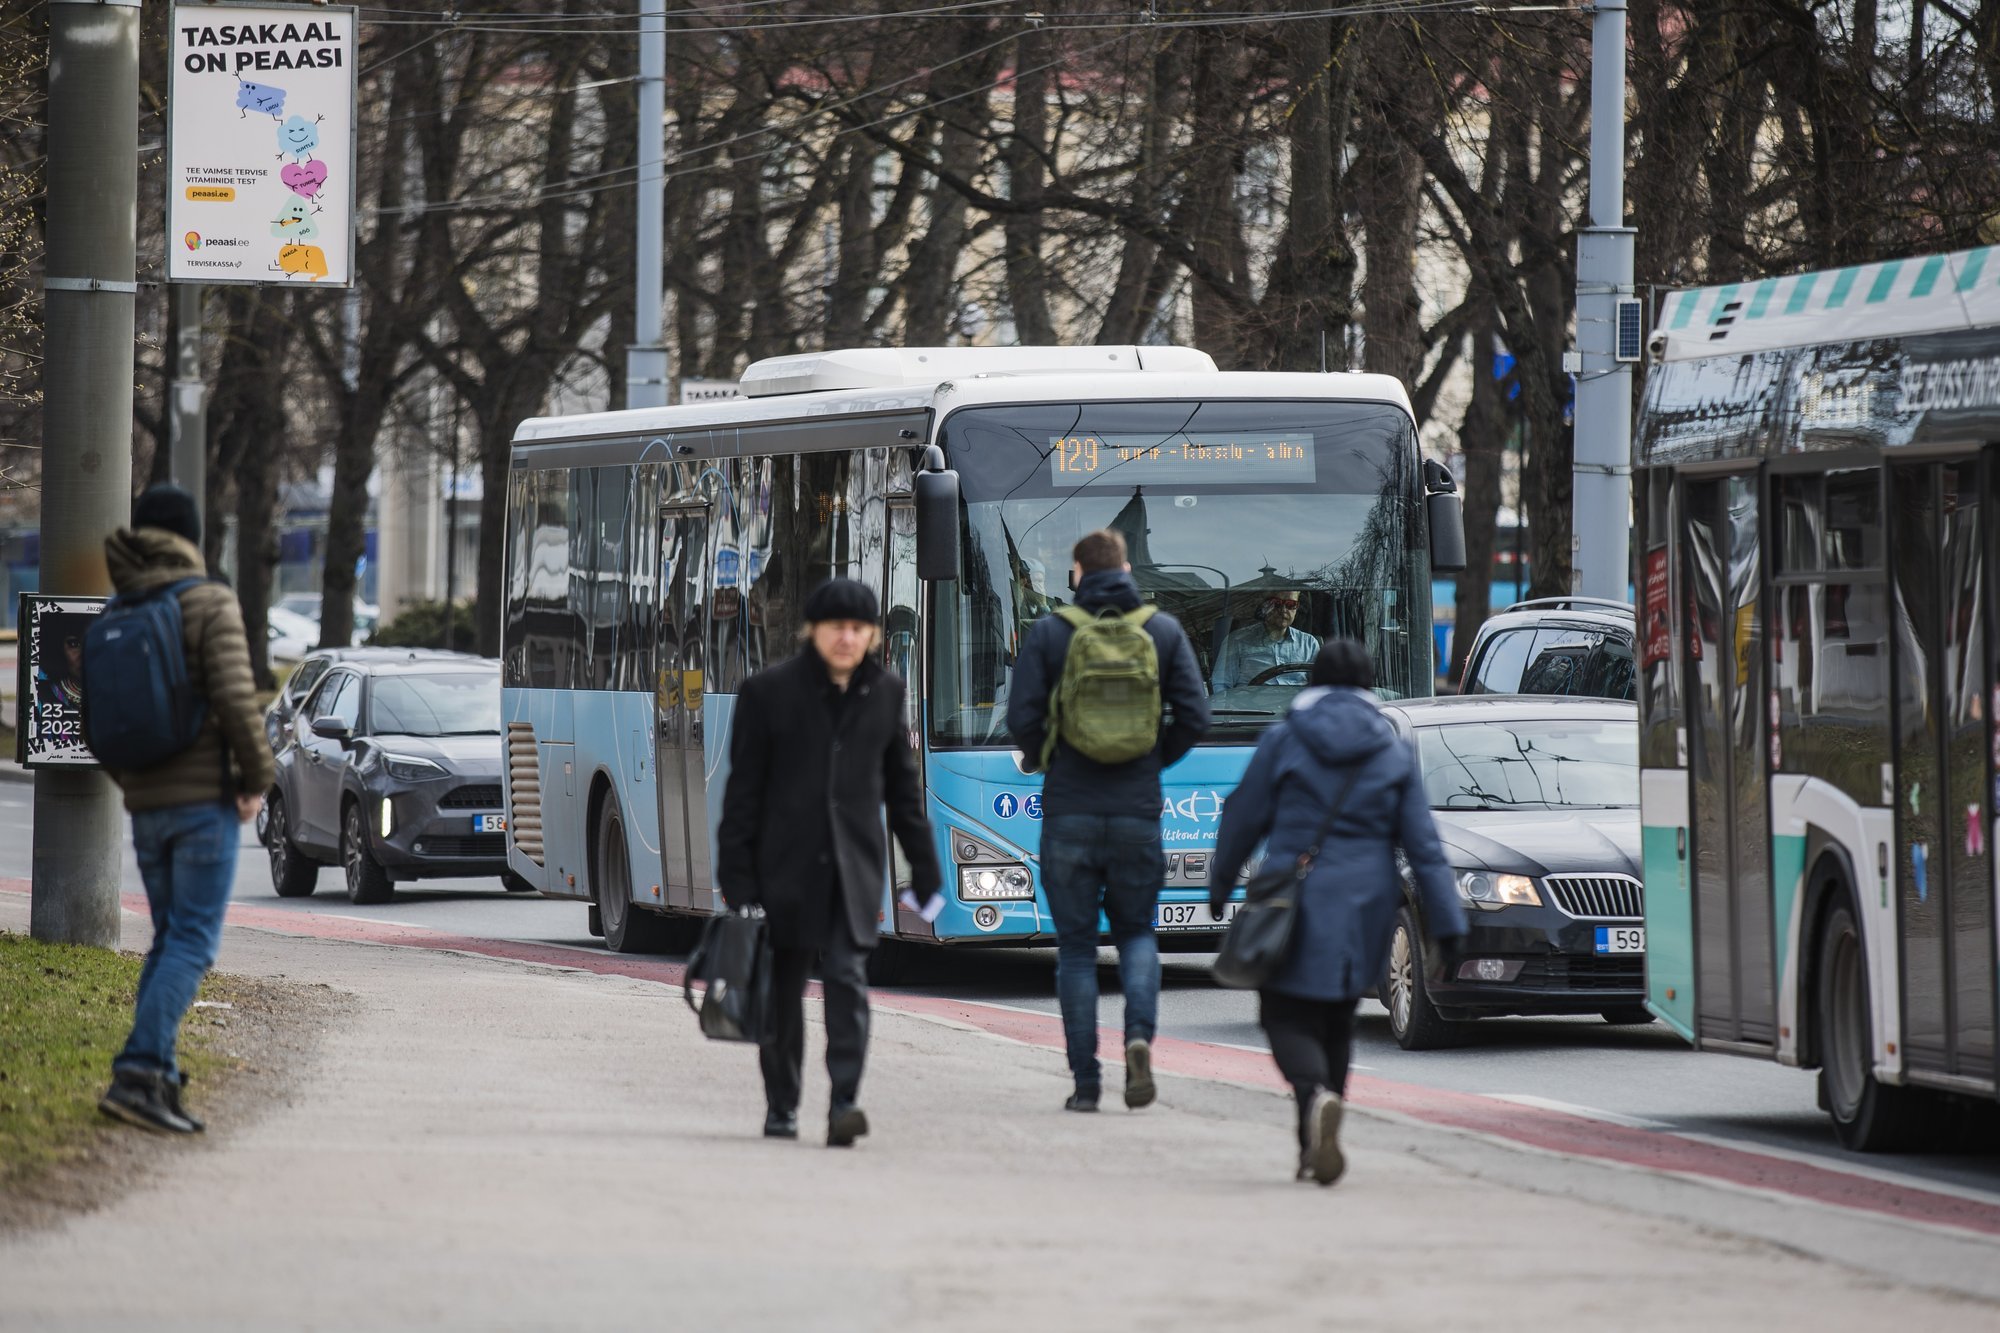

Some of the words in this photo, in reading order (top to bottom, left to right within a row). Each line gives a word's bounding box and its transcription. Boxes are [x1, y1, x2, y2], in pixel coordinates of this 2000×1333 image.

[182, 22, 341, 47] TASAKAAL
[184, 52, 227, 73] ON
[235, 48, 342, 71] PEAASI
[186, 177, 235, 185] VITAMIINIDE
[192, 190, 229, 198] peaasi.ee
[206, 237, 250, 247] peaasi.ee
[187, 260, 234, 268] TERVISEKASSA
[1056, 438, 1098, 472] 129
[41, 703, 81, 718] 23—
[41, 720, 81, 735] 2023
[1161, 828, 1201, 841] ltskond
[1163, 906, 1196, 924] 037
